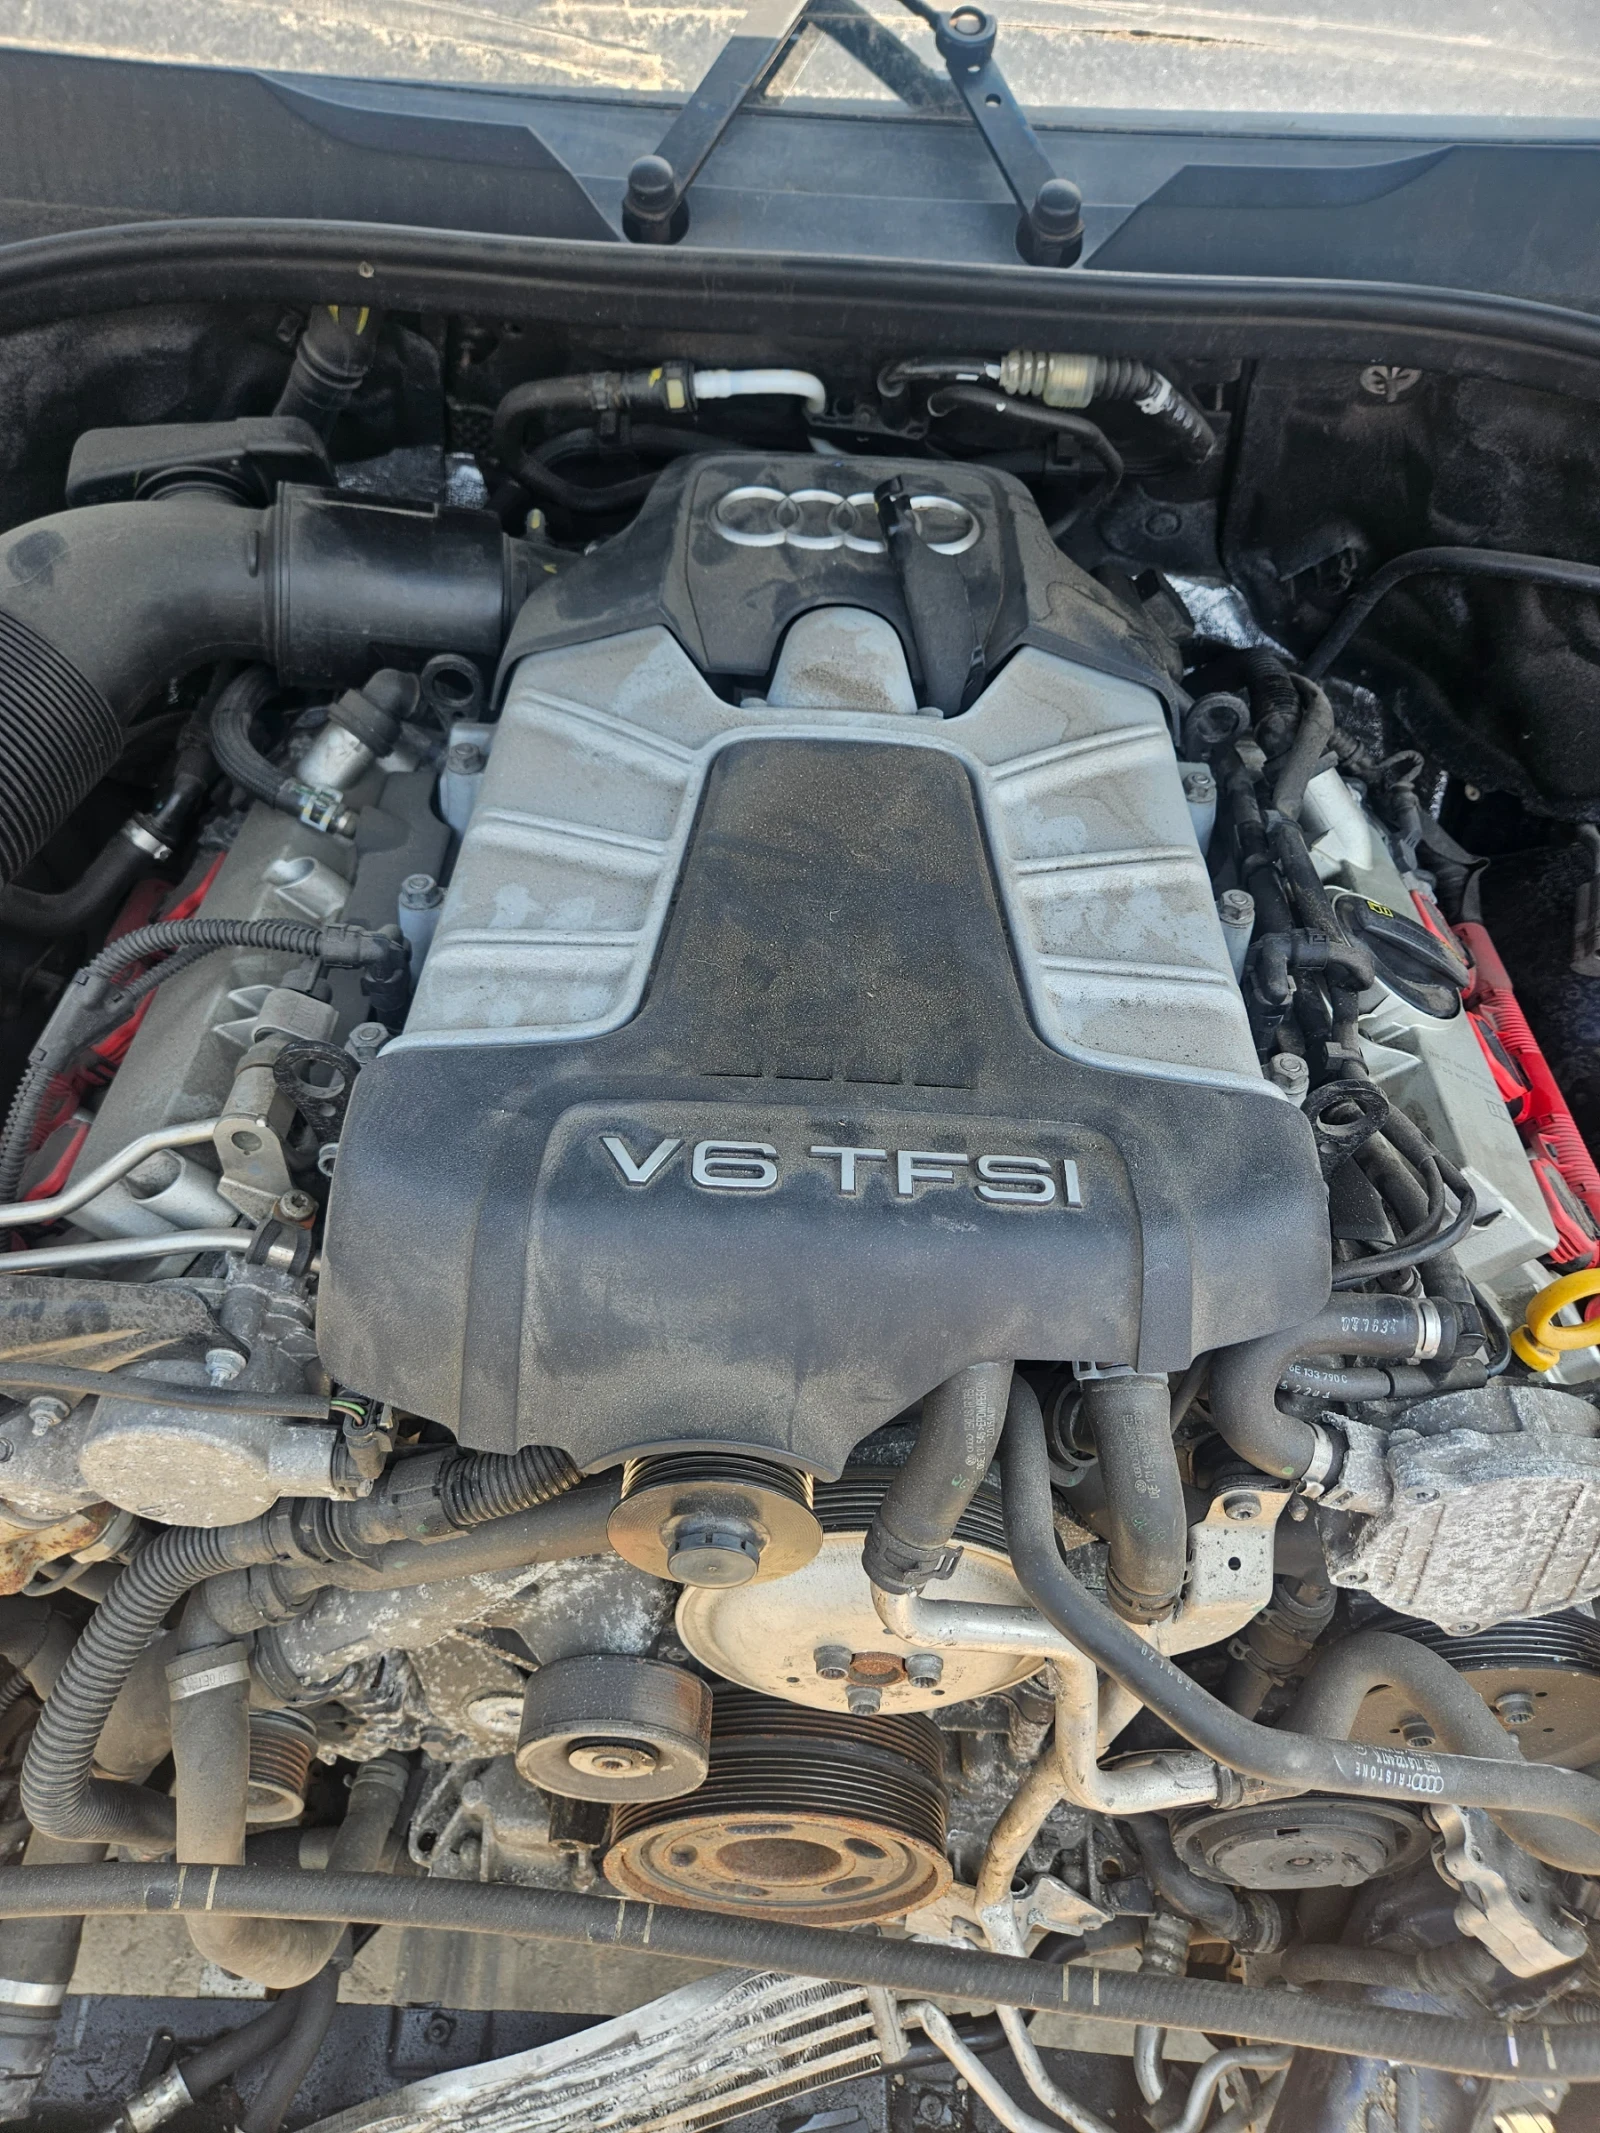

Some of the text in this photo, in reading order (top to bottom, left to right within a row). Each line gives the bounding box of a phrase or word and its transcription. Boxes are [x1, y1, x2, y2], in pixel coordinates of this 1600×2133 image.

[602, 1136, 1083, 1208] V6 TFSI
[1287, 1364, 1348, 1384] 6E 133 790 C
[1355, 1761, 1412, 1788] TRISTONE
